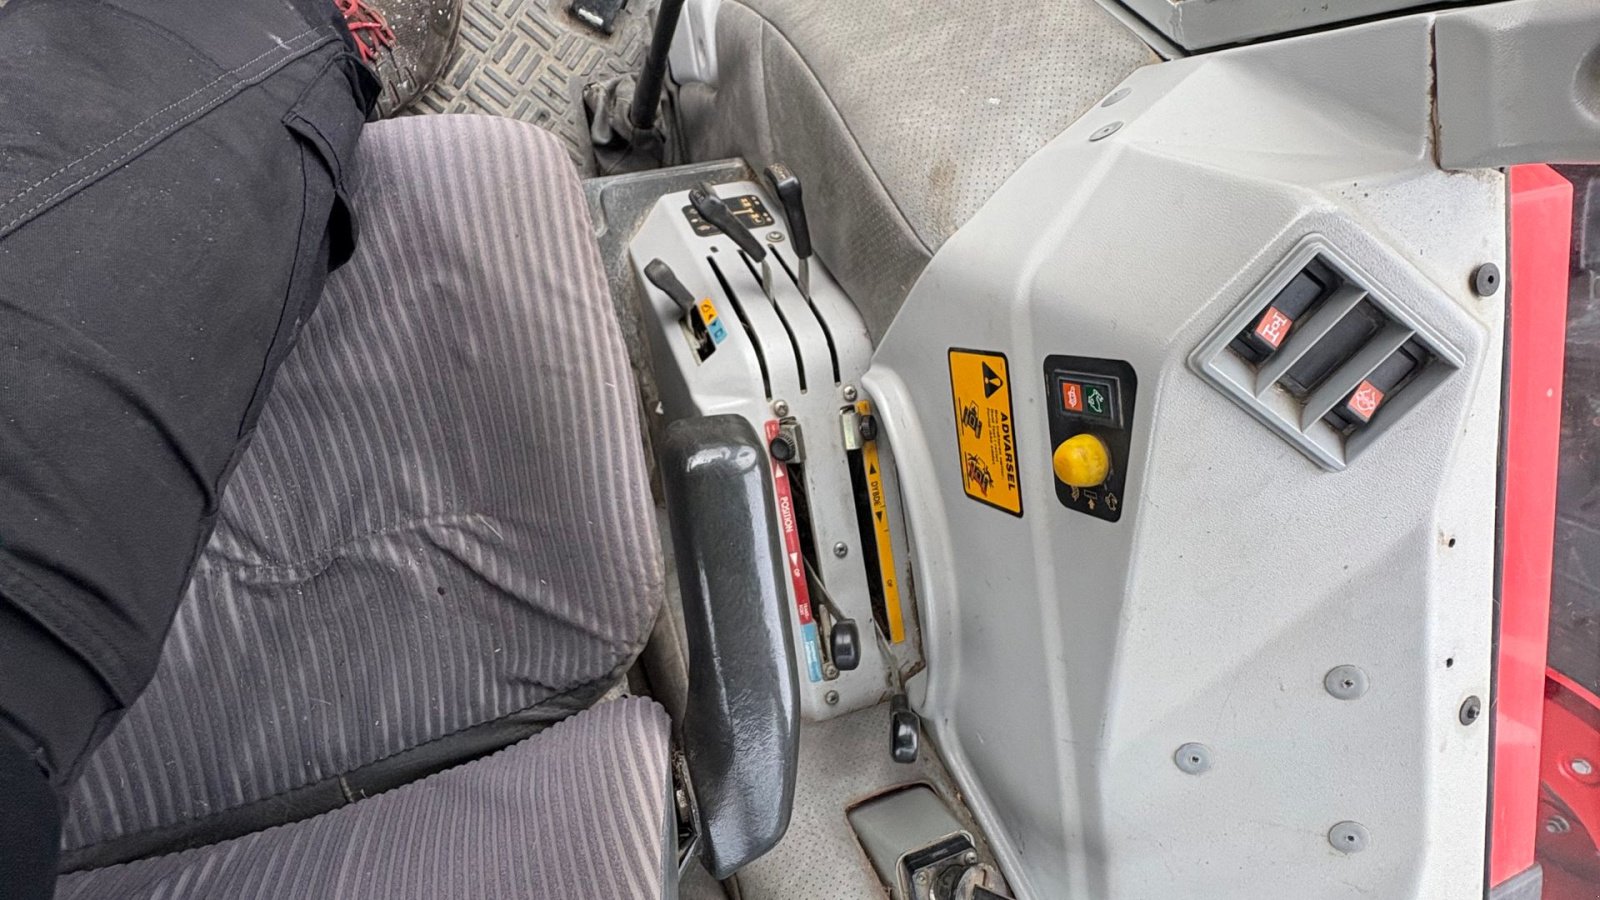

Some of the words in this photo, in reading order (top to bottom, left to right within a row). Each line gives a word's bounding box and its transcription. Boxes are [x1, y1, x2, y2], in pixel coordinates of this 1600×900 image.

[1001, 411, 1016, 491] ADVARSEL
[871, 481, 881, 506] DYBDE
[780, 496, 794, 533] POSITION
